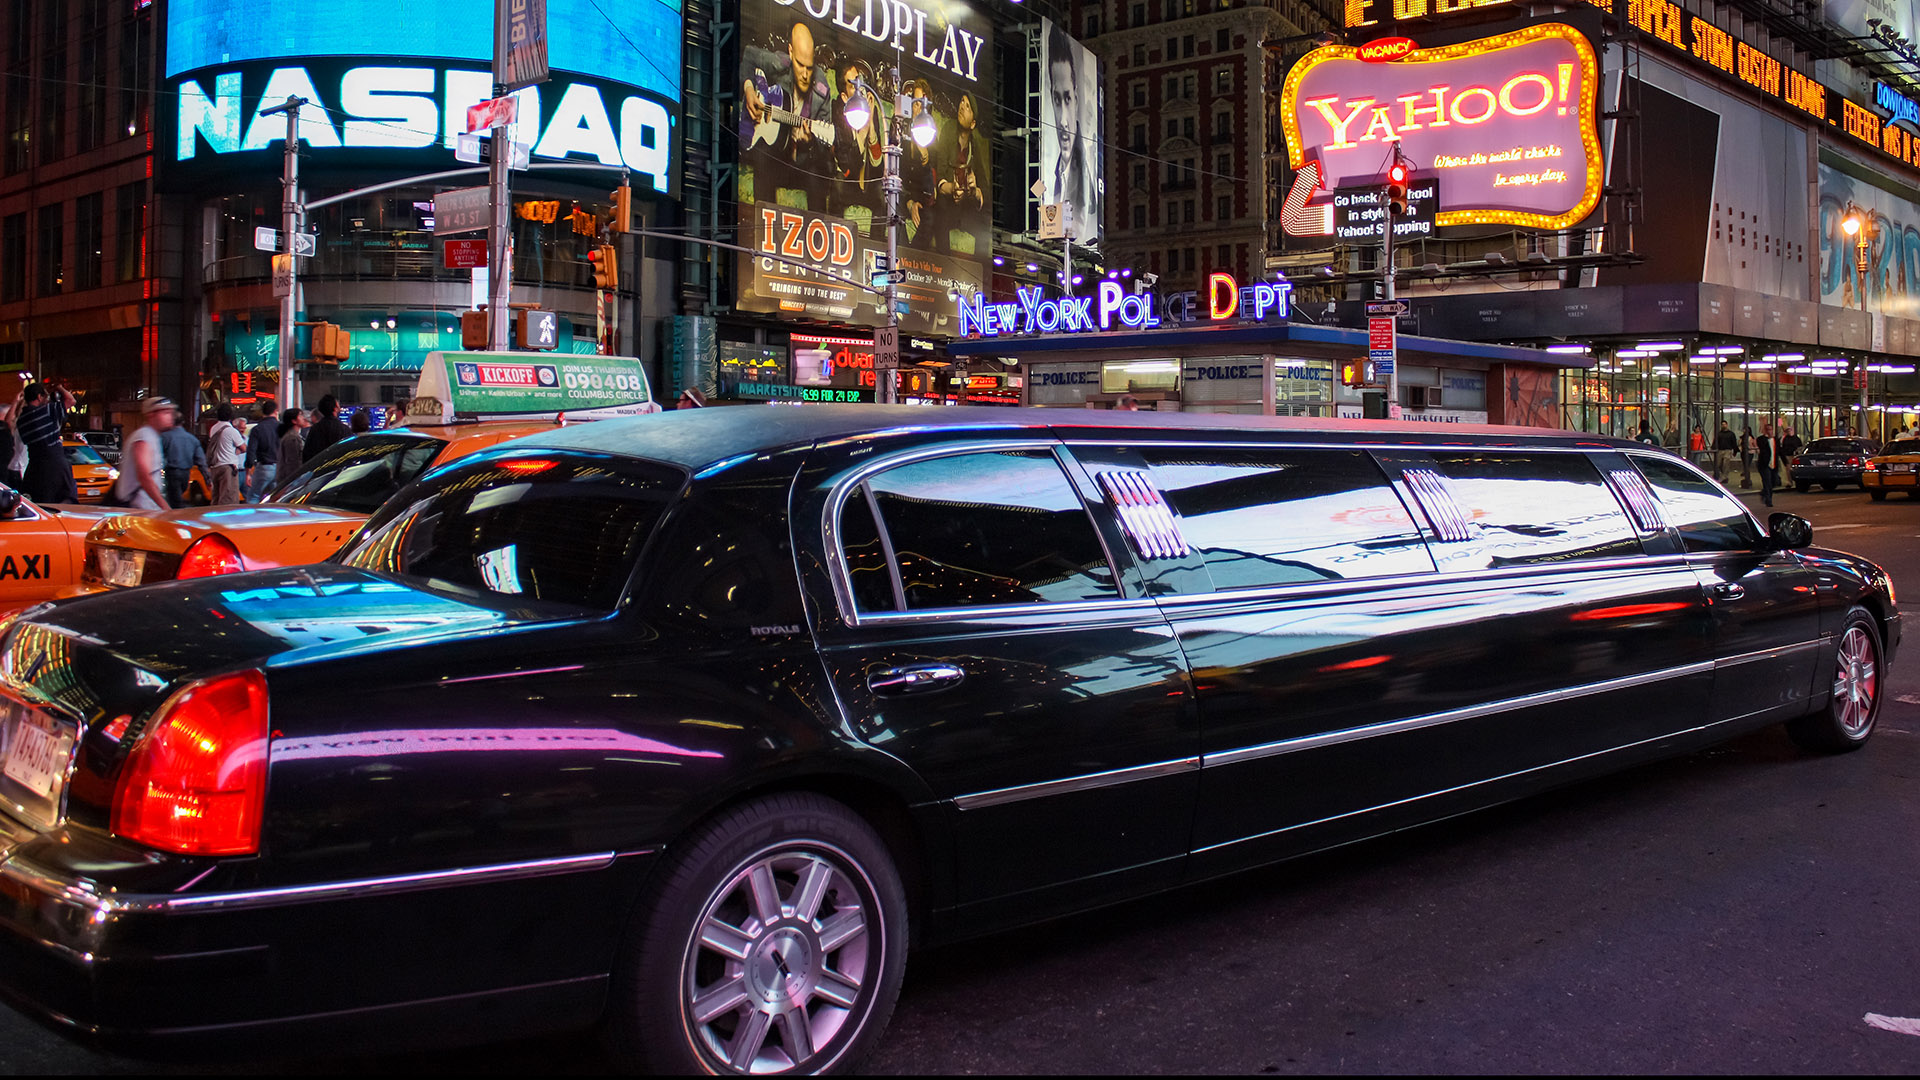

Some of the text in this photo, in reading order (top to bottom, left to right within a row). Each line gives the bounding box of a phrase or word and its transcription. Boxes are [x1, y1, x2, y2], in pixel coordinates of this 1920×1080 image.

[1361, 39, 1411, 60] VACANCY
[1691, 16, 1734, 75] STORM
[1737, 41, 1780, 97] GUSTAV
[1843, 98, 1880, 148] FEDERER
[1305, 62, 1575, 152] YAHOO!
[176, 66, 670, 194] NASDAQ
[468, 142, 489, 156] ONE
[1469, 153, 1488, 165] the
[1334, 195, 1349, 207] Go
[1407, 186, 1433, 200] hool
[443, 210, 481, 227] W 43 ST
[1348, 210, 1359, 221] in
[1337, 220, 1430, 237] Yahoo! Spping
[264, 235, 283, 245] ONE
[762, 208, 854, 266] IZOD
[761, 256, 852, 282] CENTER
[912, 261, 919, 269] La
[920, 261, 931, 271] Vida
[931, 264, 943, 273] Tour
[907, 271, 925, 283] October
[803, 287, 815, 297] YOU
[817, 288, 828, 299] THE
[958, 271, 1293, 338] NEW YORK POLICE DEPT
[880, 332, 893, 346] NO
[875, 352, 898, 364] TURNS
[463, 373, 477, 382] NFL
[483, 367, 533, 383] KICKOFF
[562, 365, 581, 373] JOIN
[594, 366, 638, 375] THURSDAY
[1197, 365, 1248, 381] POLICE
[1287, 365, 1320, 380] POLICE
[565, 373, 641, 391] 090408
[1042, 371, 1087, 386] POLICE
[459, 389, 480, 397] Usher
[568, 389, 644, 400] COLUMBUS CIRCLE
[821, 389, 834, 401] FOR
[836, 390, 845, 401] 24
[847, 390, 861, 402] EXP.
[415, 399, 434, 414] 9Y42
[751, 623, 800, 636] ROYALE
